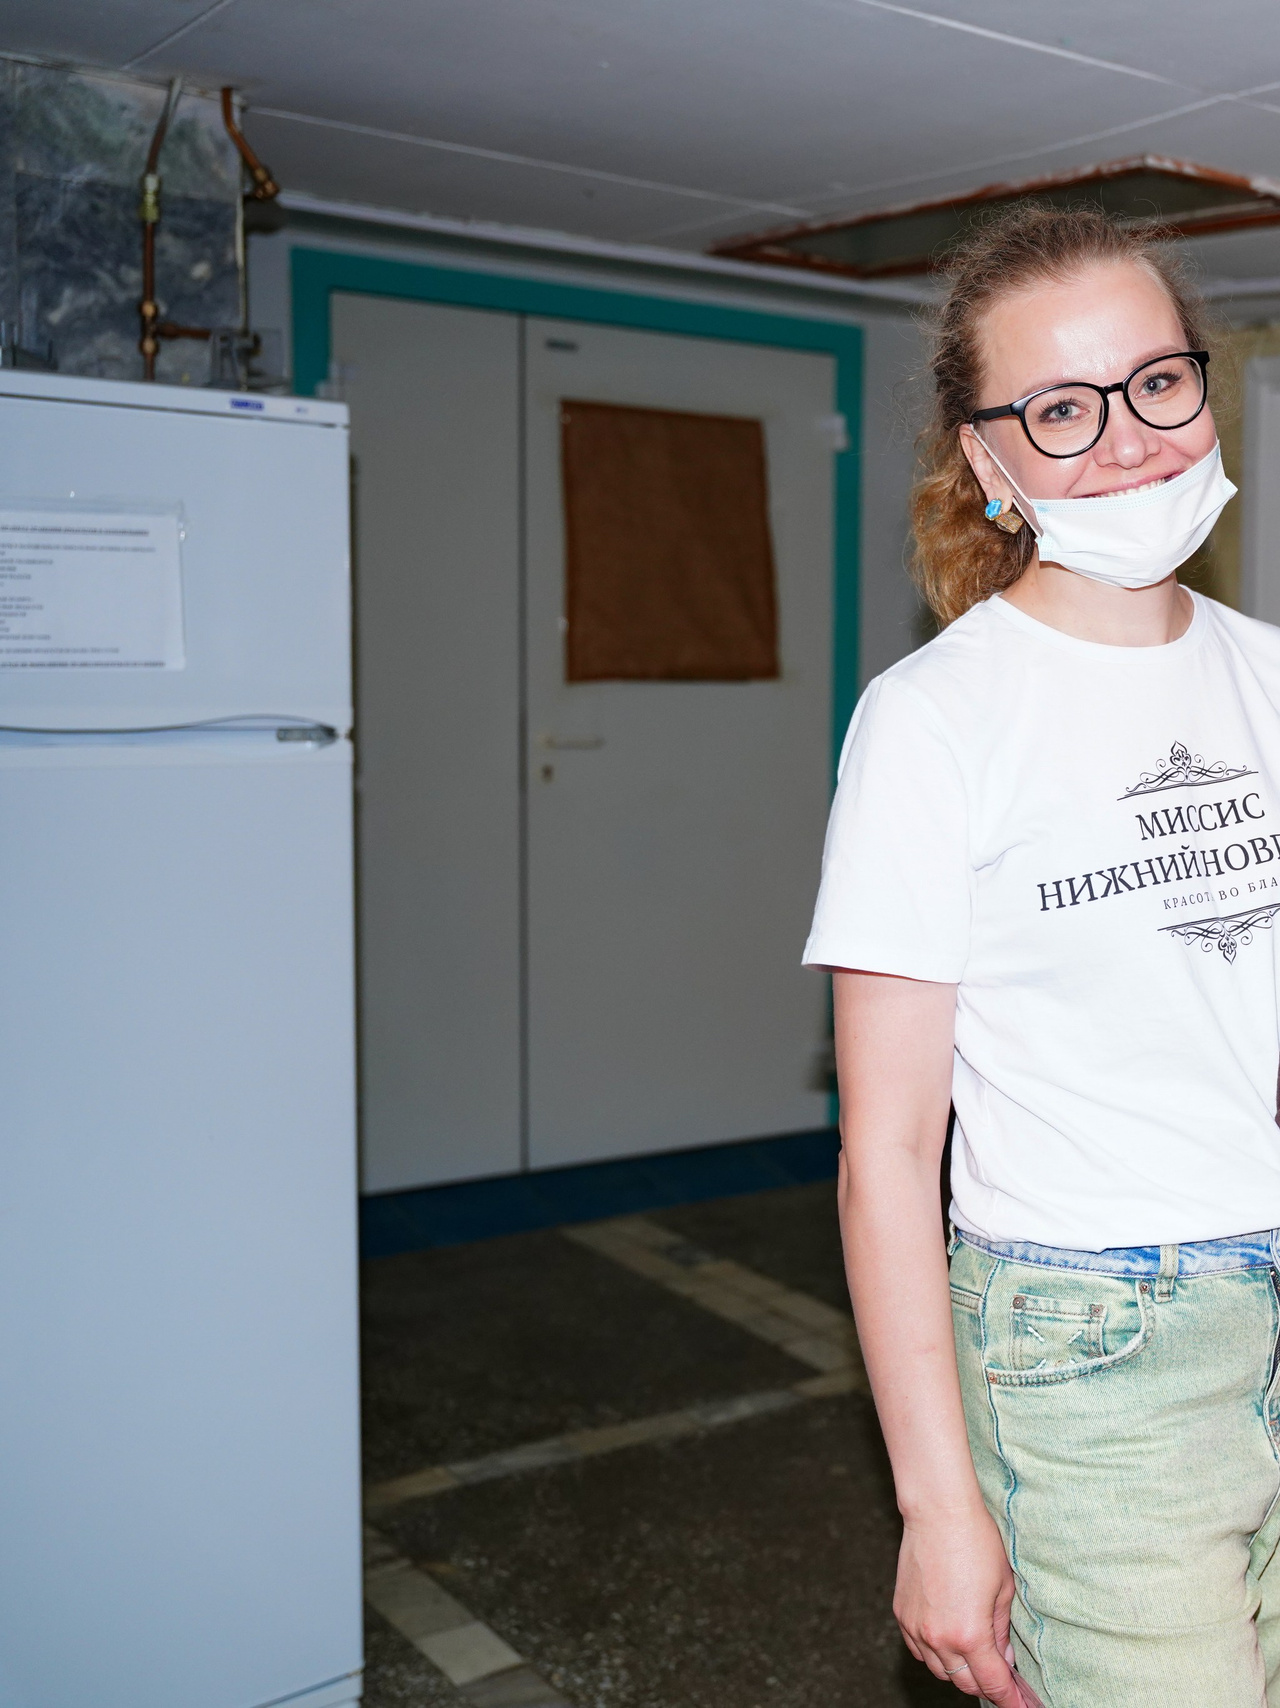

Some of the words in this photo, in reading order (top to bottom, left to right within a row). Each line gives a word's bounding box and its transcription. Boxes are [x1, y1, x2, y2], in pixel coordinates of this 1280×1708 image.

[1135, 792, 1266, 841] МИССИС
[1163, 891, 1215, 910] КРАСОТ
[1218, 887, 1239, 901] ВО
